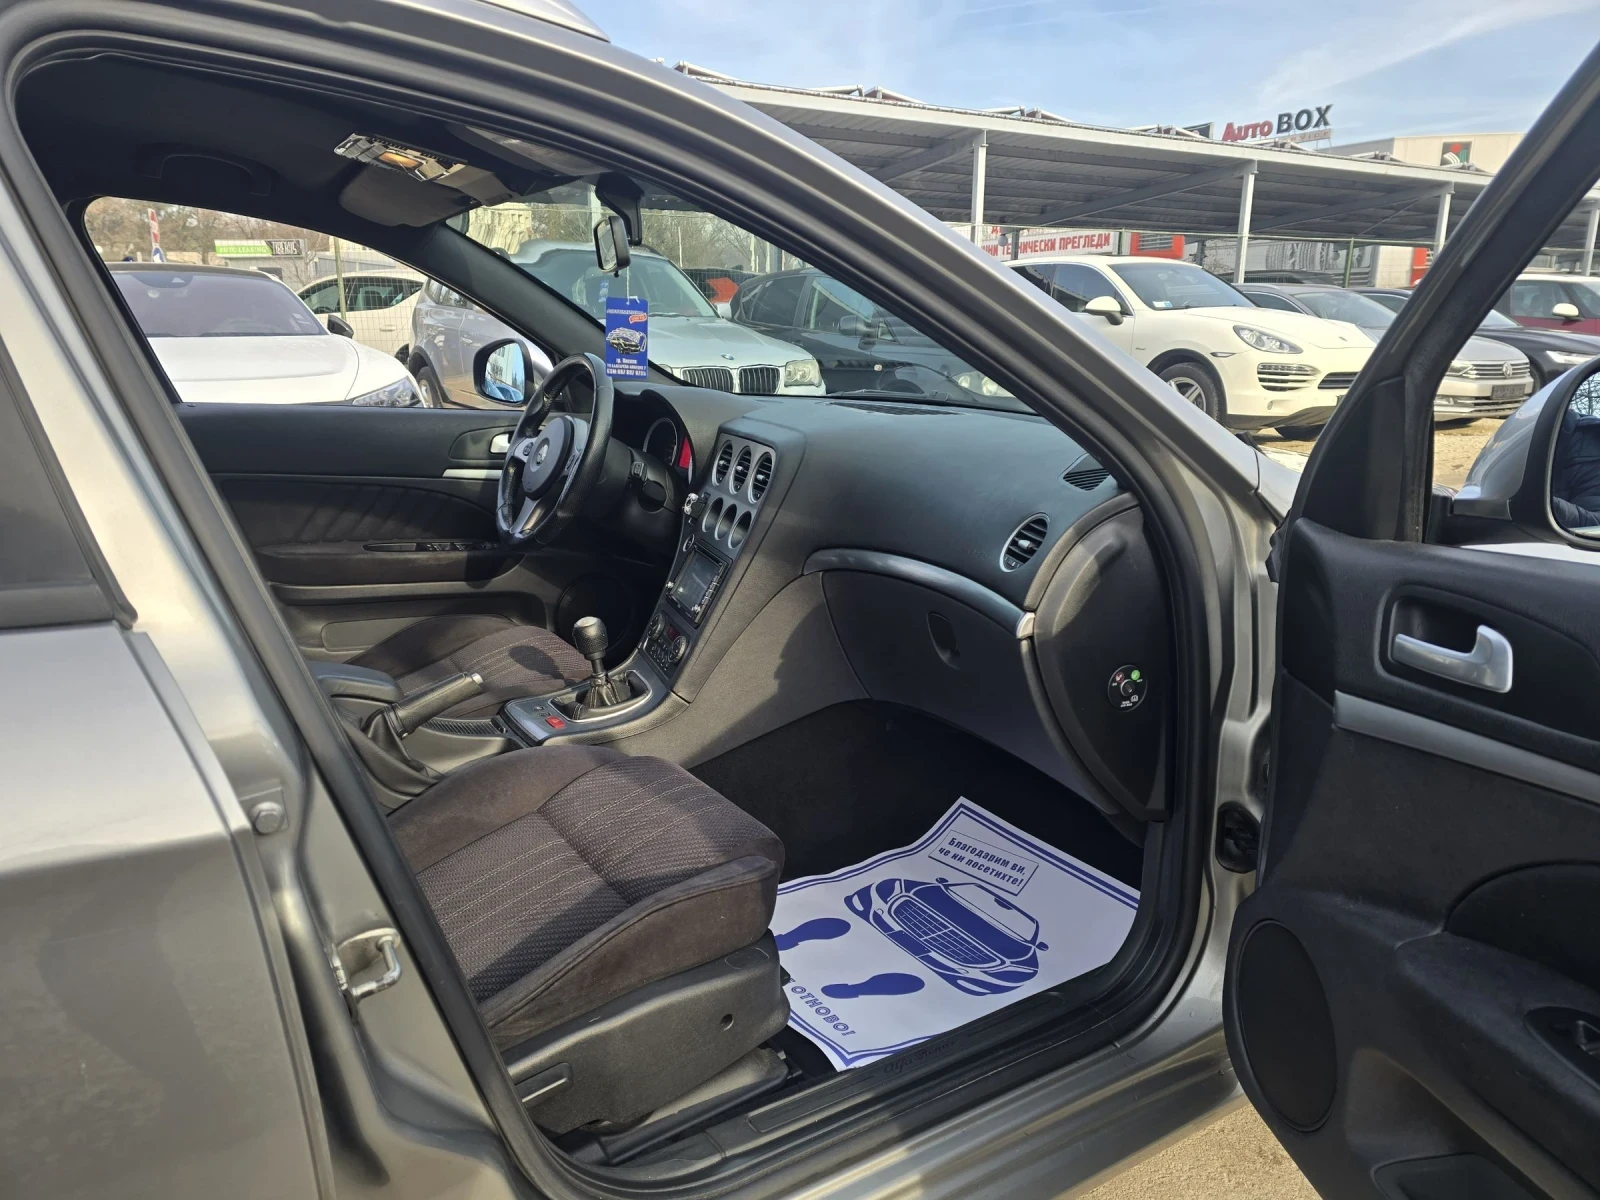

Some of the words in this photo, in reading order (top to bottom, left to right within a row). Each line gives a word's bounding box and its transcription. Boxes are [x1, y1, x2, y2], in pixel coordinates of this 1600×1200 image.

[1276, 103, 1333, 134] BOX
[1001, 238, 1056, 256] ТЕНИЧЕСКИ
[1059, 232, 1111, 251] ПРЕГЛЕДИ
[938, 847, 951, 856] че
[951, 853, 966, 863] ни
[965, 858, 1025, 887] посетихте!
[948, 837, 1011, 868] Благодарим
[1010, 863, 1026, 876] ви,
[791, 985, 856, 1036] ОТНОВО!
